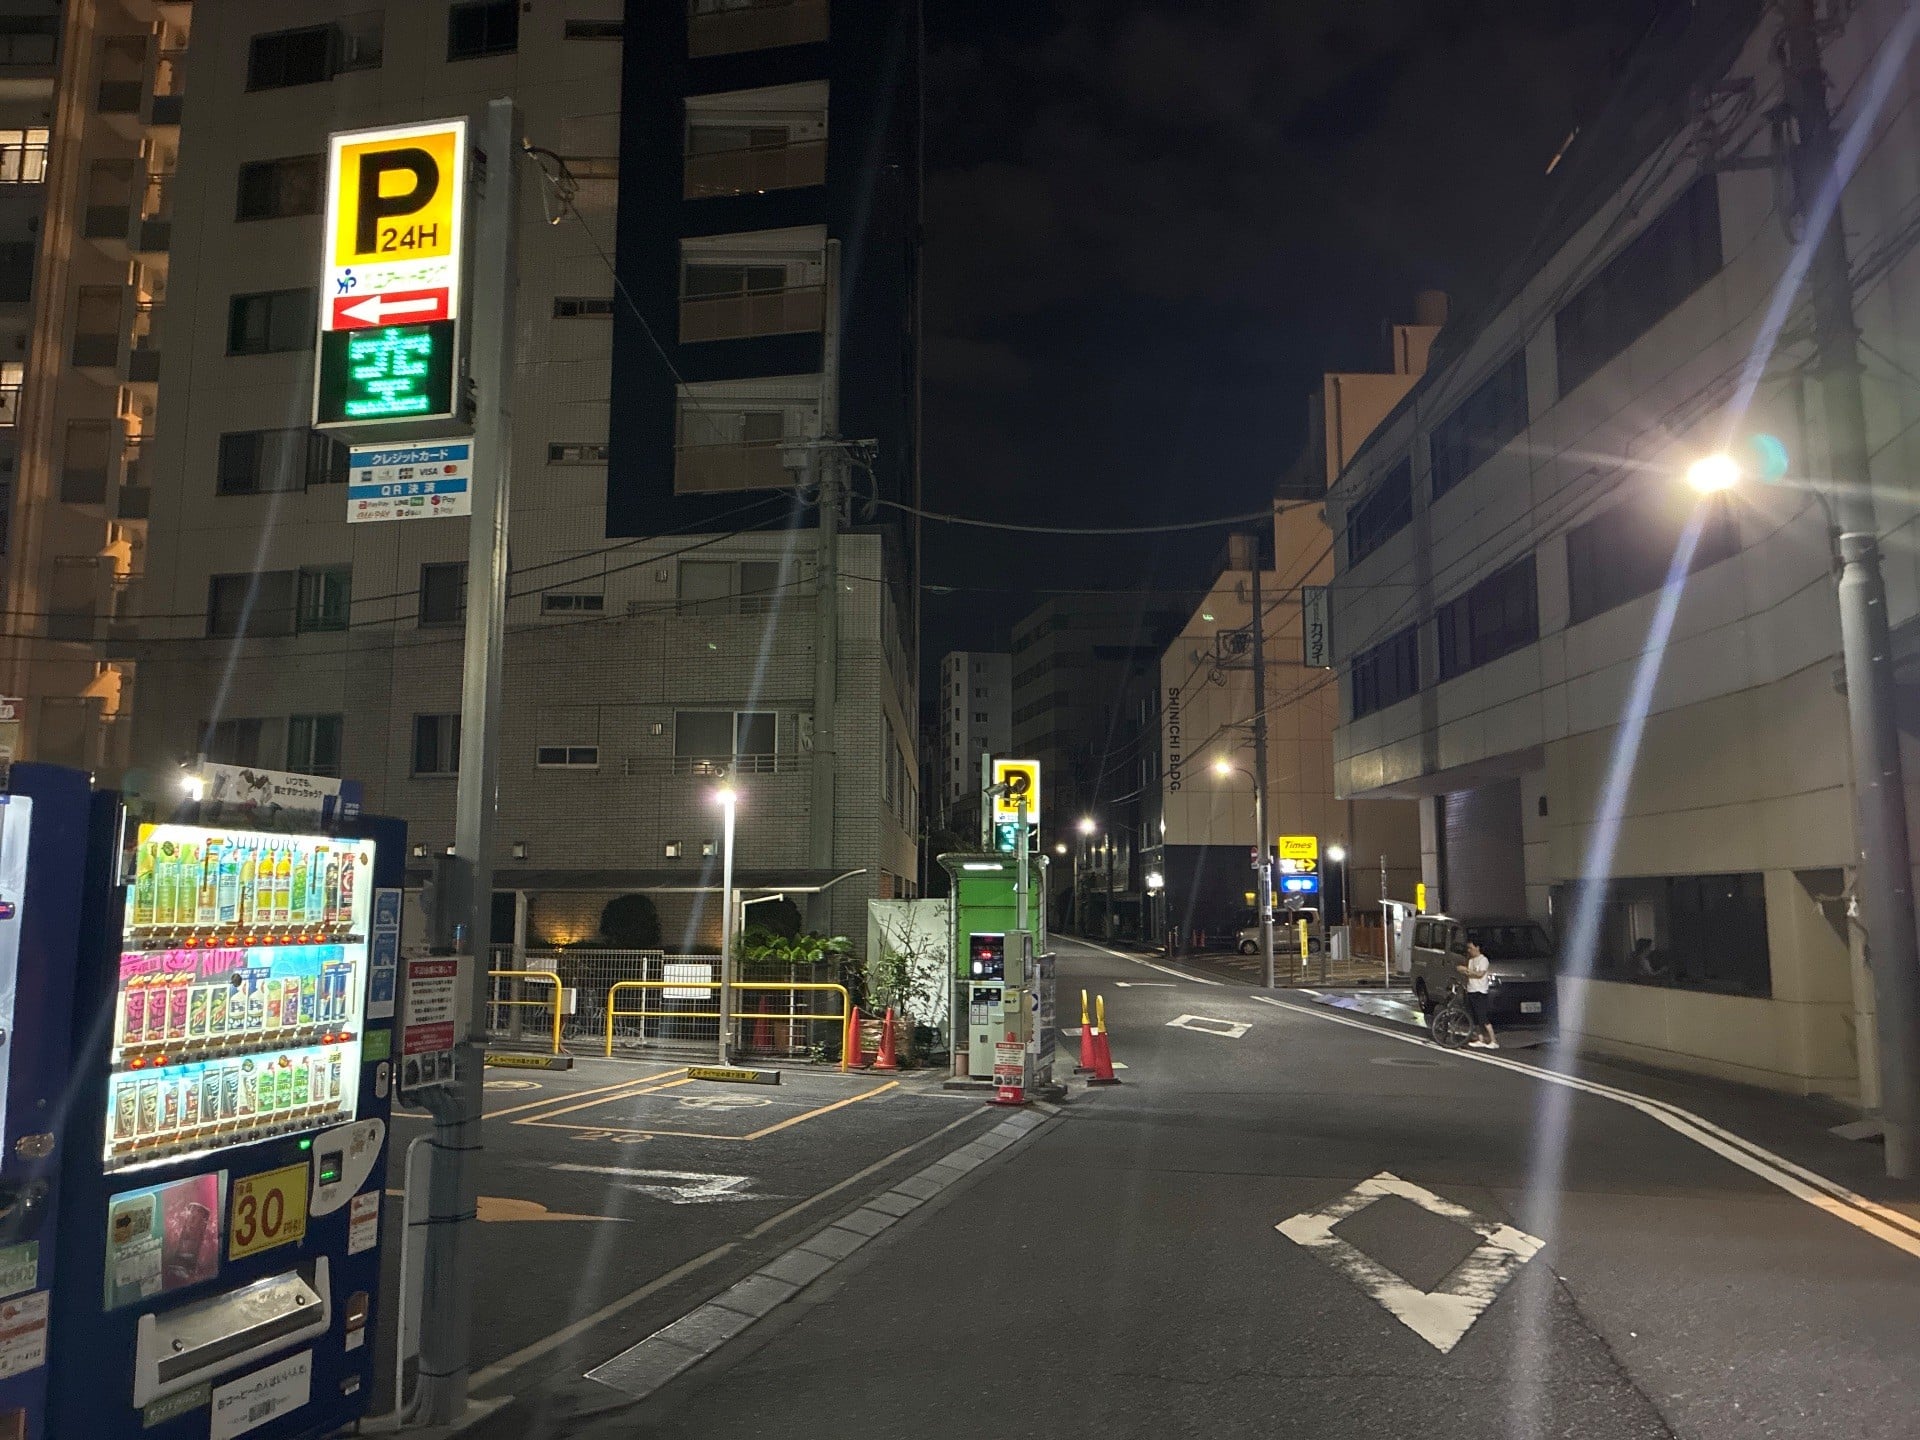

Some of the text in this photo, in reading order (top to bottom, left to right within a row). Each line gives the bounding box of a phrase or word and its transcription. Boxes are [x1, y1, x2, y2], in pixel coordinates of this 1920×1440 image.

[355, 147, 440, 256] P
[381, 223, 438, 253] 24H
[346, 328, 431, 415] 空
[372, 449, 449, 465] クレジットカード
[420, 467, 438, 476] VISA
[1168, 687, 1181, 795] SHINICHI BLDG.
[1003, 769, 1032, 808] P
[1285, 840, 1312, 849] Times
[235, 1188, 284, 1246] 30
